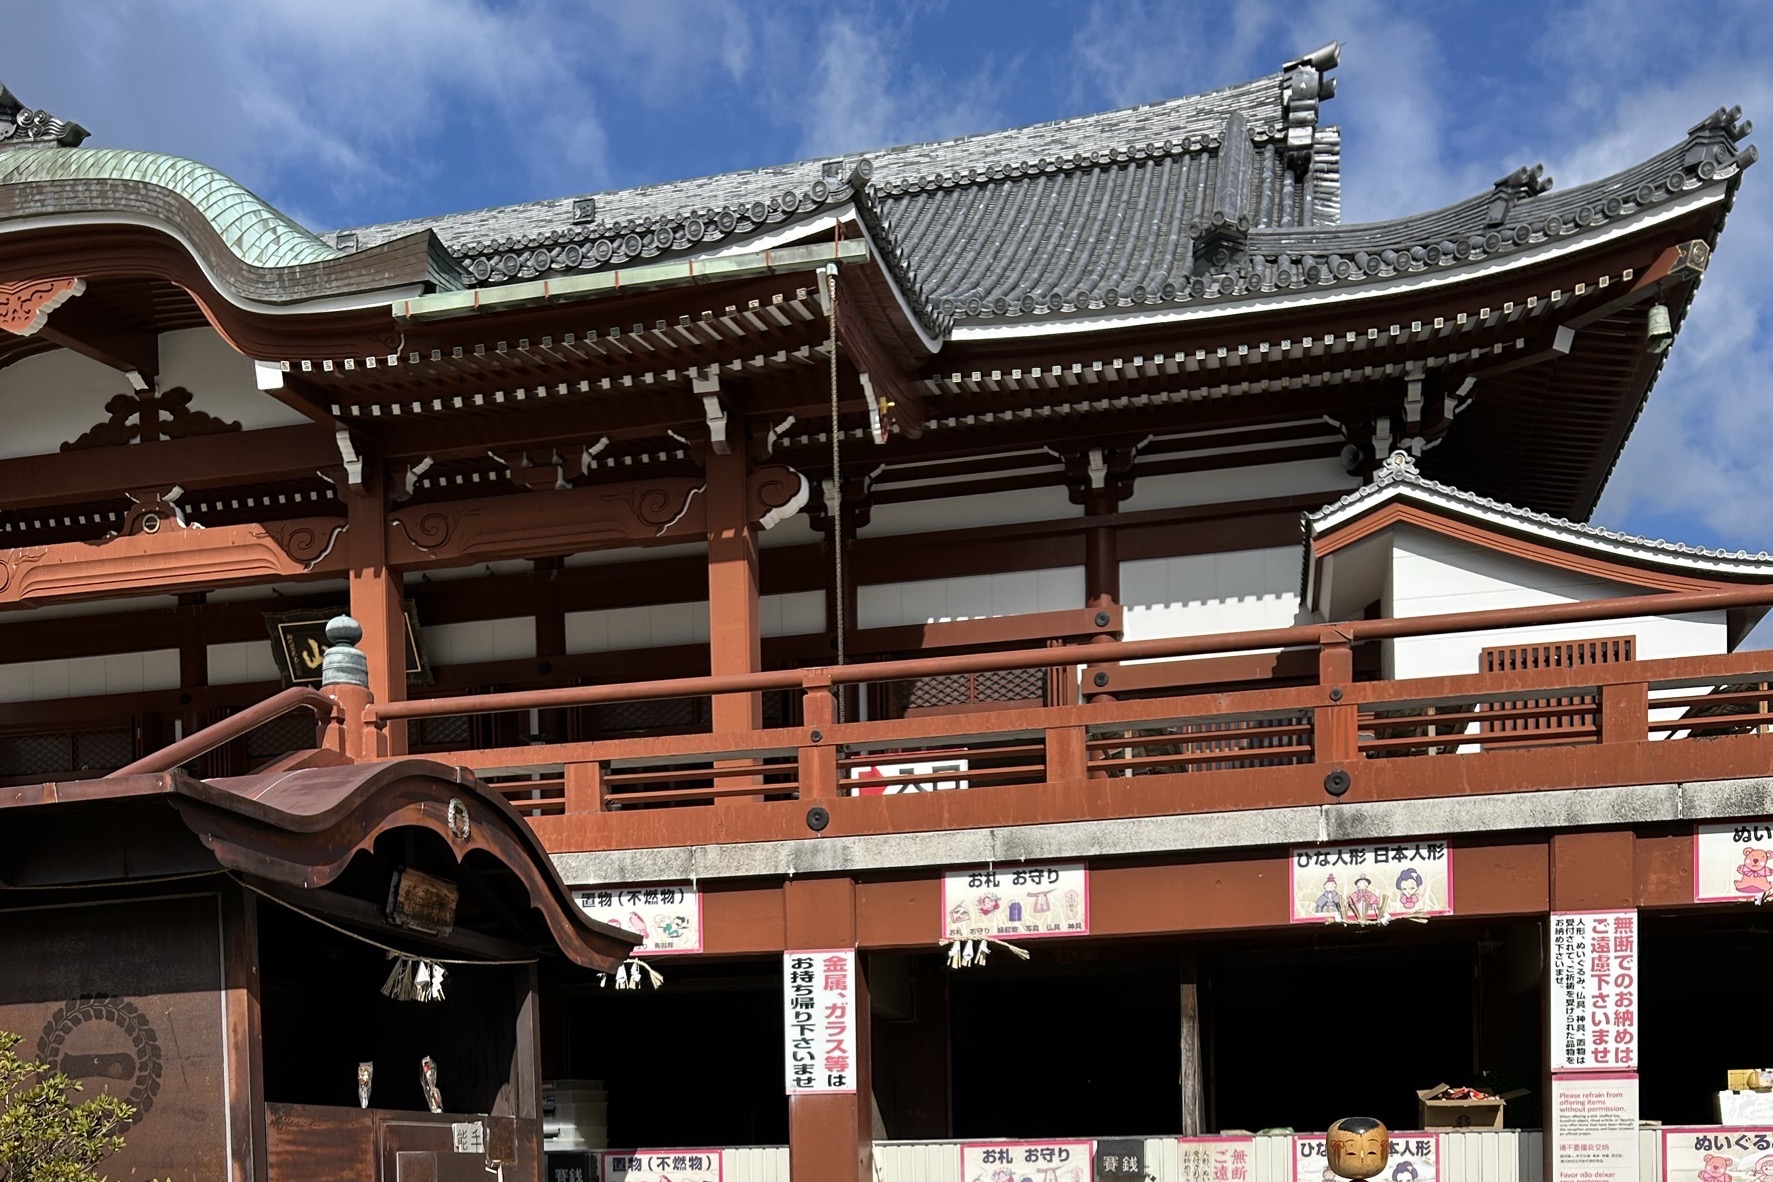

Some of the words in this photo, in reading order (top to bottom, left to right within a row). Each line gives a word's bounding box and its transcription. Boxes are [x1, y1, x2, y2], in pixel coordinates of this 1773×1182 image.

[1296, 847, 1366, 868] ひな人形
[1374, 843, 1445, 864] 日本人形
[968, 871, 1000, 888] お札
[1012, 868, 1059, 886] お守り
[1590, 917, 1611, 1063] ご遠慮下さいませ
[1613, 916, 1634, 1063] 無断でのお納めは
[790, 957, 816, 1088] お持ち帰り下さいませ
[823, 955, 849, 1087] 金属、ガラス等は
[1587, 1105, 1626, 1113] permission.
[1389, 1140, 1432, 1157] 本人形
[1694, 1134, 1773, 1151] ぬいぐる
[982, 1148, 1013, 1164] お札
[1024, 1147, 1070, 1163] お守り
[1103, 1155, 1138, 1173] 賽銭
